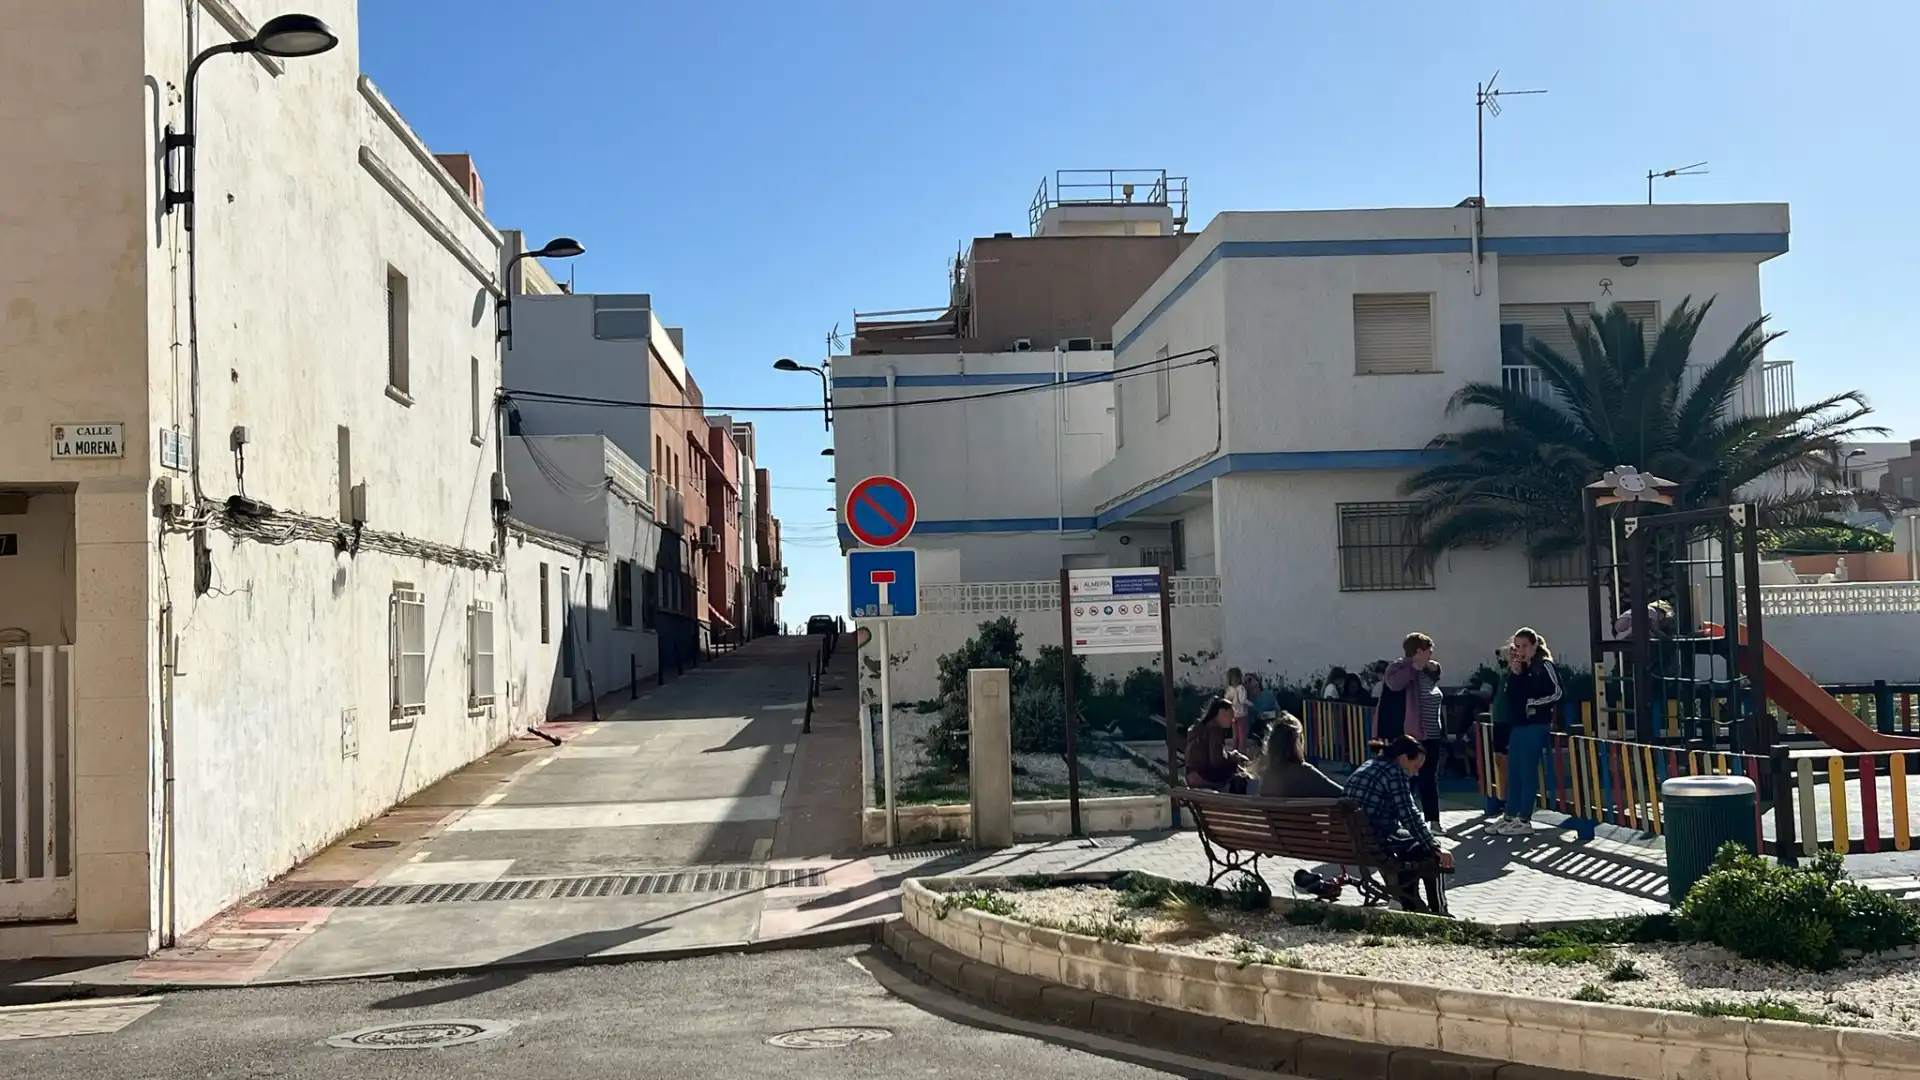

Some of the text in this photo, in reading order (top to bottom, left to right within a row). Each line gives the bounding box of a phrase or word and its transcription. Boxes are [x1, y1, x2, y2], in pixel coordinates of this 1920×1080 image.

[76, 427, 112, 436] CALLE
[57, 441, 118, 455] LA MORENA
